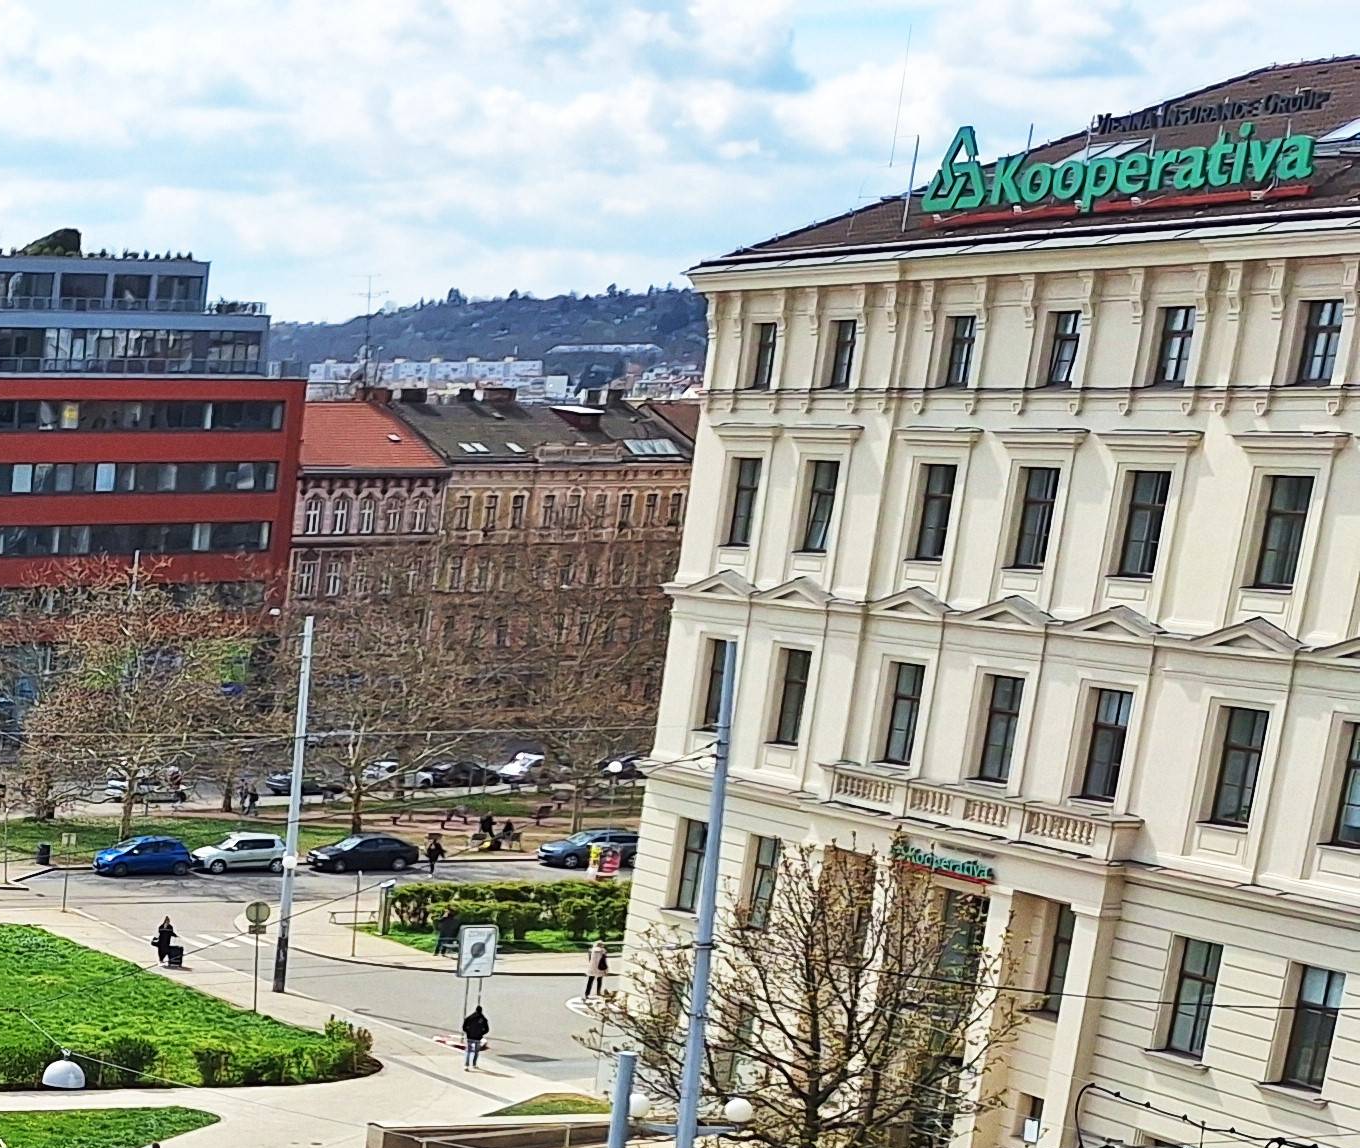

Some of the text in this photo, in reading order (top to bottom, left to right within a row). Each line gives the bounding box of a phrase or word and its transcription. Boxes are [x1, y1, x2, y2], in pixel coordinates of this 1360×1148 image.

[1097, 91, 1330, 134] VIENNA INSURANCE GROUP
[991, 122, 1316, 211] Kooperativa
